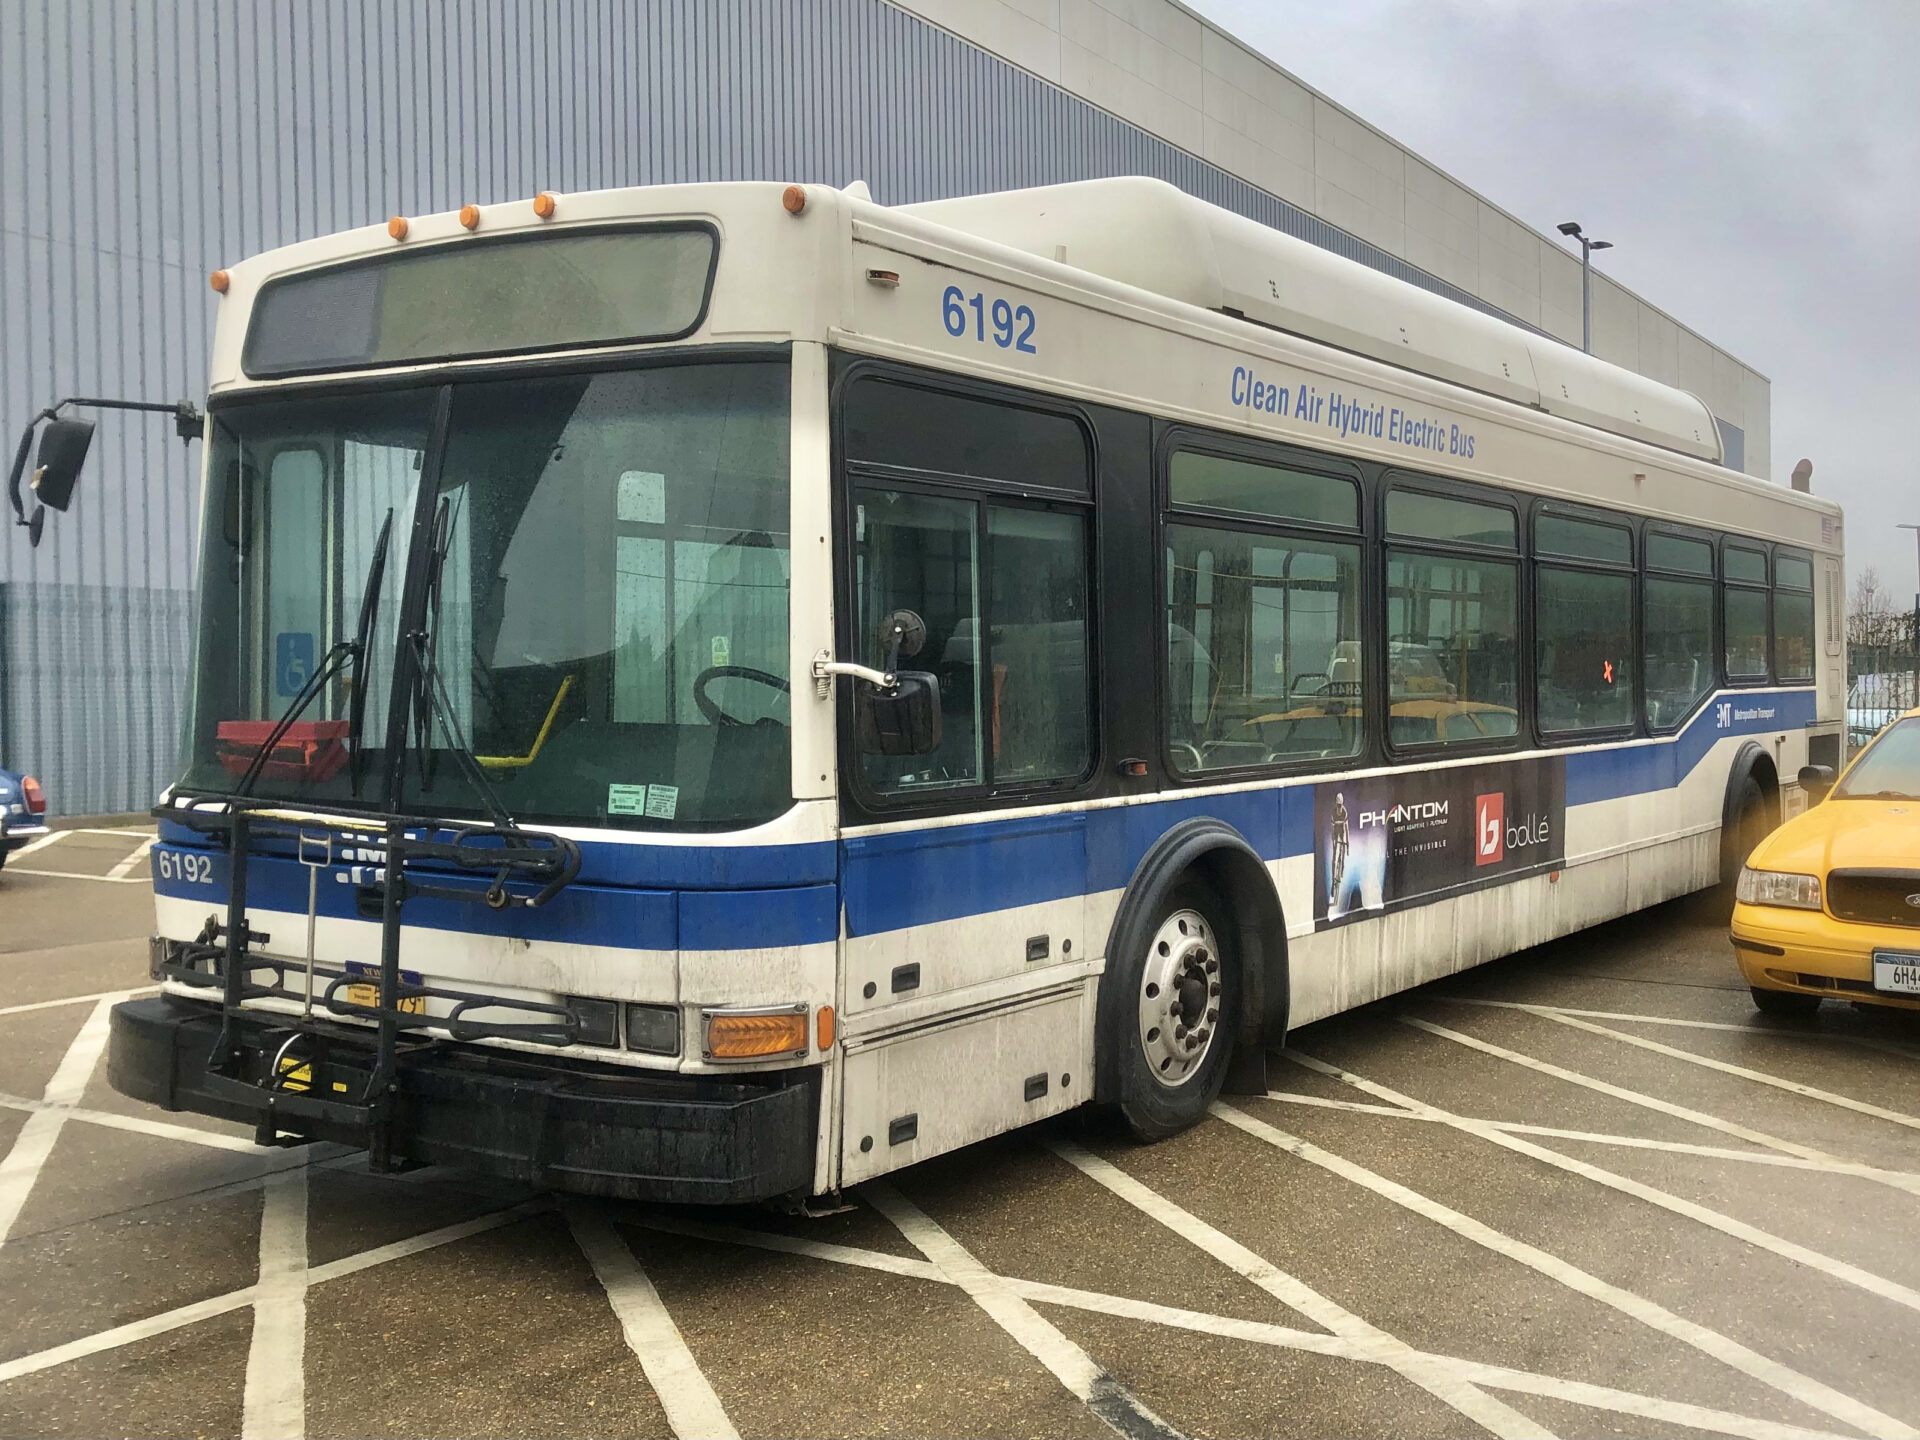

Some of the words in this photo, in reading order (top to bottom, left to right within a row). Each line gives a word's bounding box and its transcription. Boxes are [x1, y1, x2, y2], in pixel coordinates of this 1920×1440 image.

[942, 285, 1036, 354] 6192
[1231, 366, 1289, 416] Clean
[1294, 384, 1323, 424] Air
[1328, 392, 1384, 438] Hybrid
[1388, 408, 1445, 453] Electric
[1449, 424, 1475, 459] Bus
[1359, 800, 1448, 829] PHANTOM
[1506, 812, 1549, 849] bollé
[1411, 839, 1447, 853] INVISIBLE
[159, 850, 213, 884] 6192
